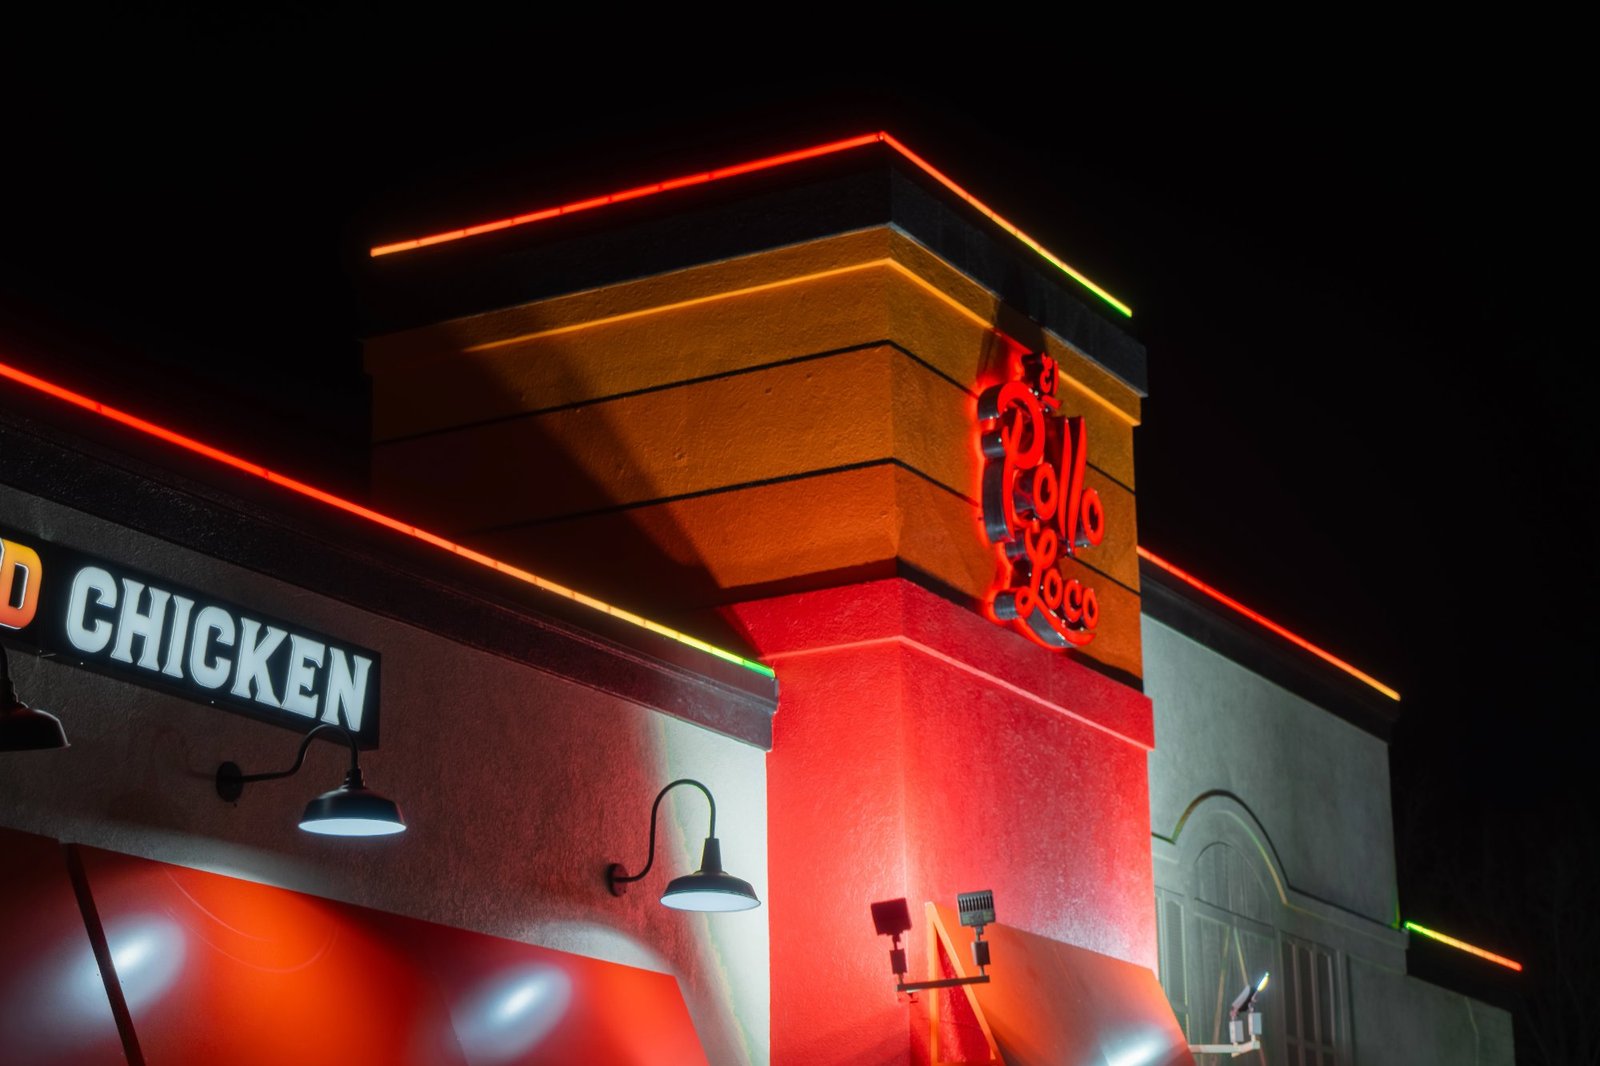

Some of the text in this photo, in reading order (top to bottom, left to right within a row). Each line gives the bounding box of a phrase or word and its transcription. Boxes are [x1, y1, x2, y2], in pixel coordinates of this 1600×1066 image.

[993, 381, 1105, 556] Pollo
[66, 566, 373, 732] CHICKEN
[1011, 528, 1099, 647] Loco
